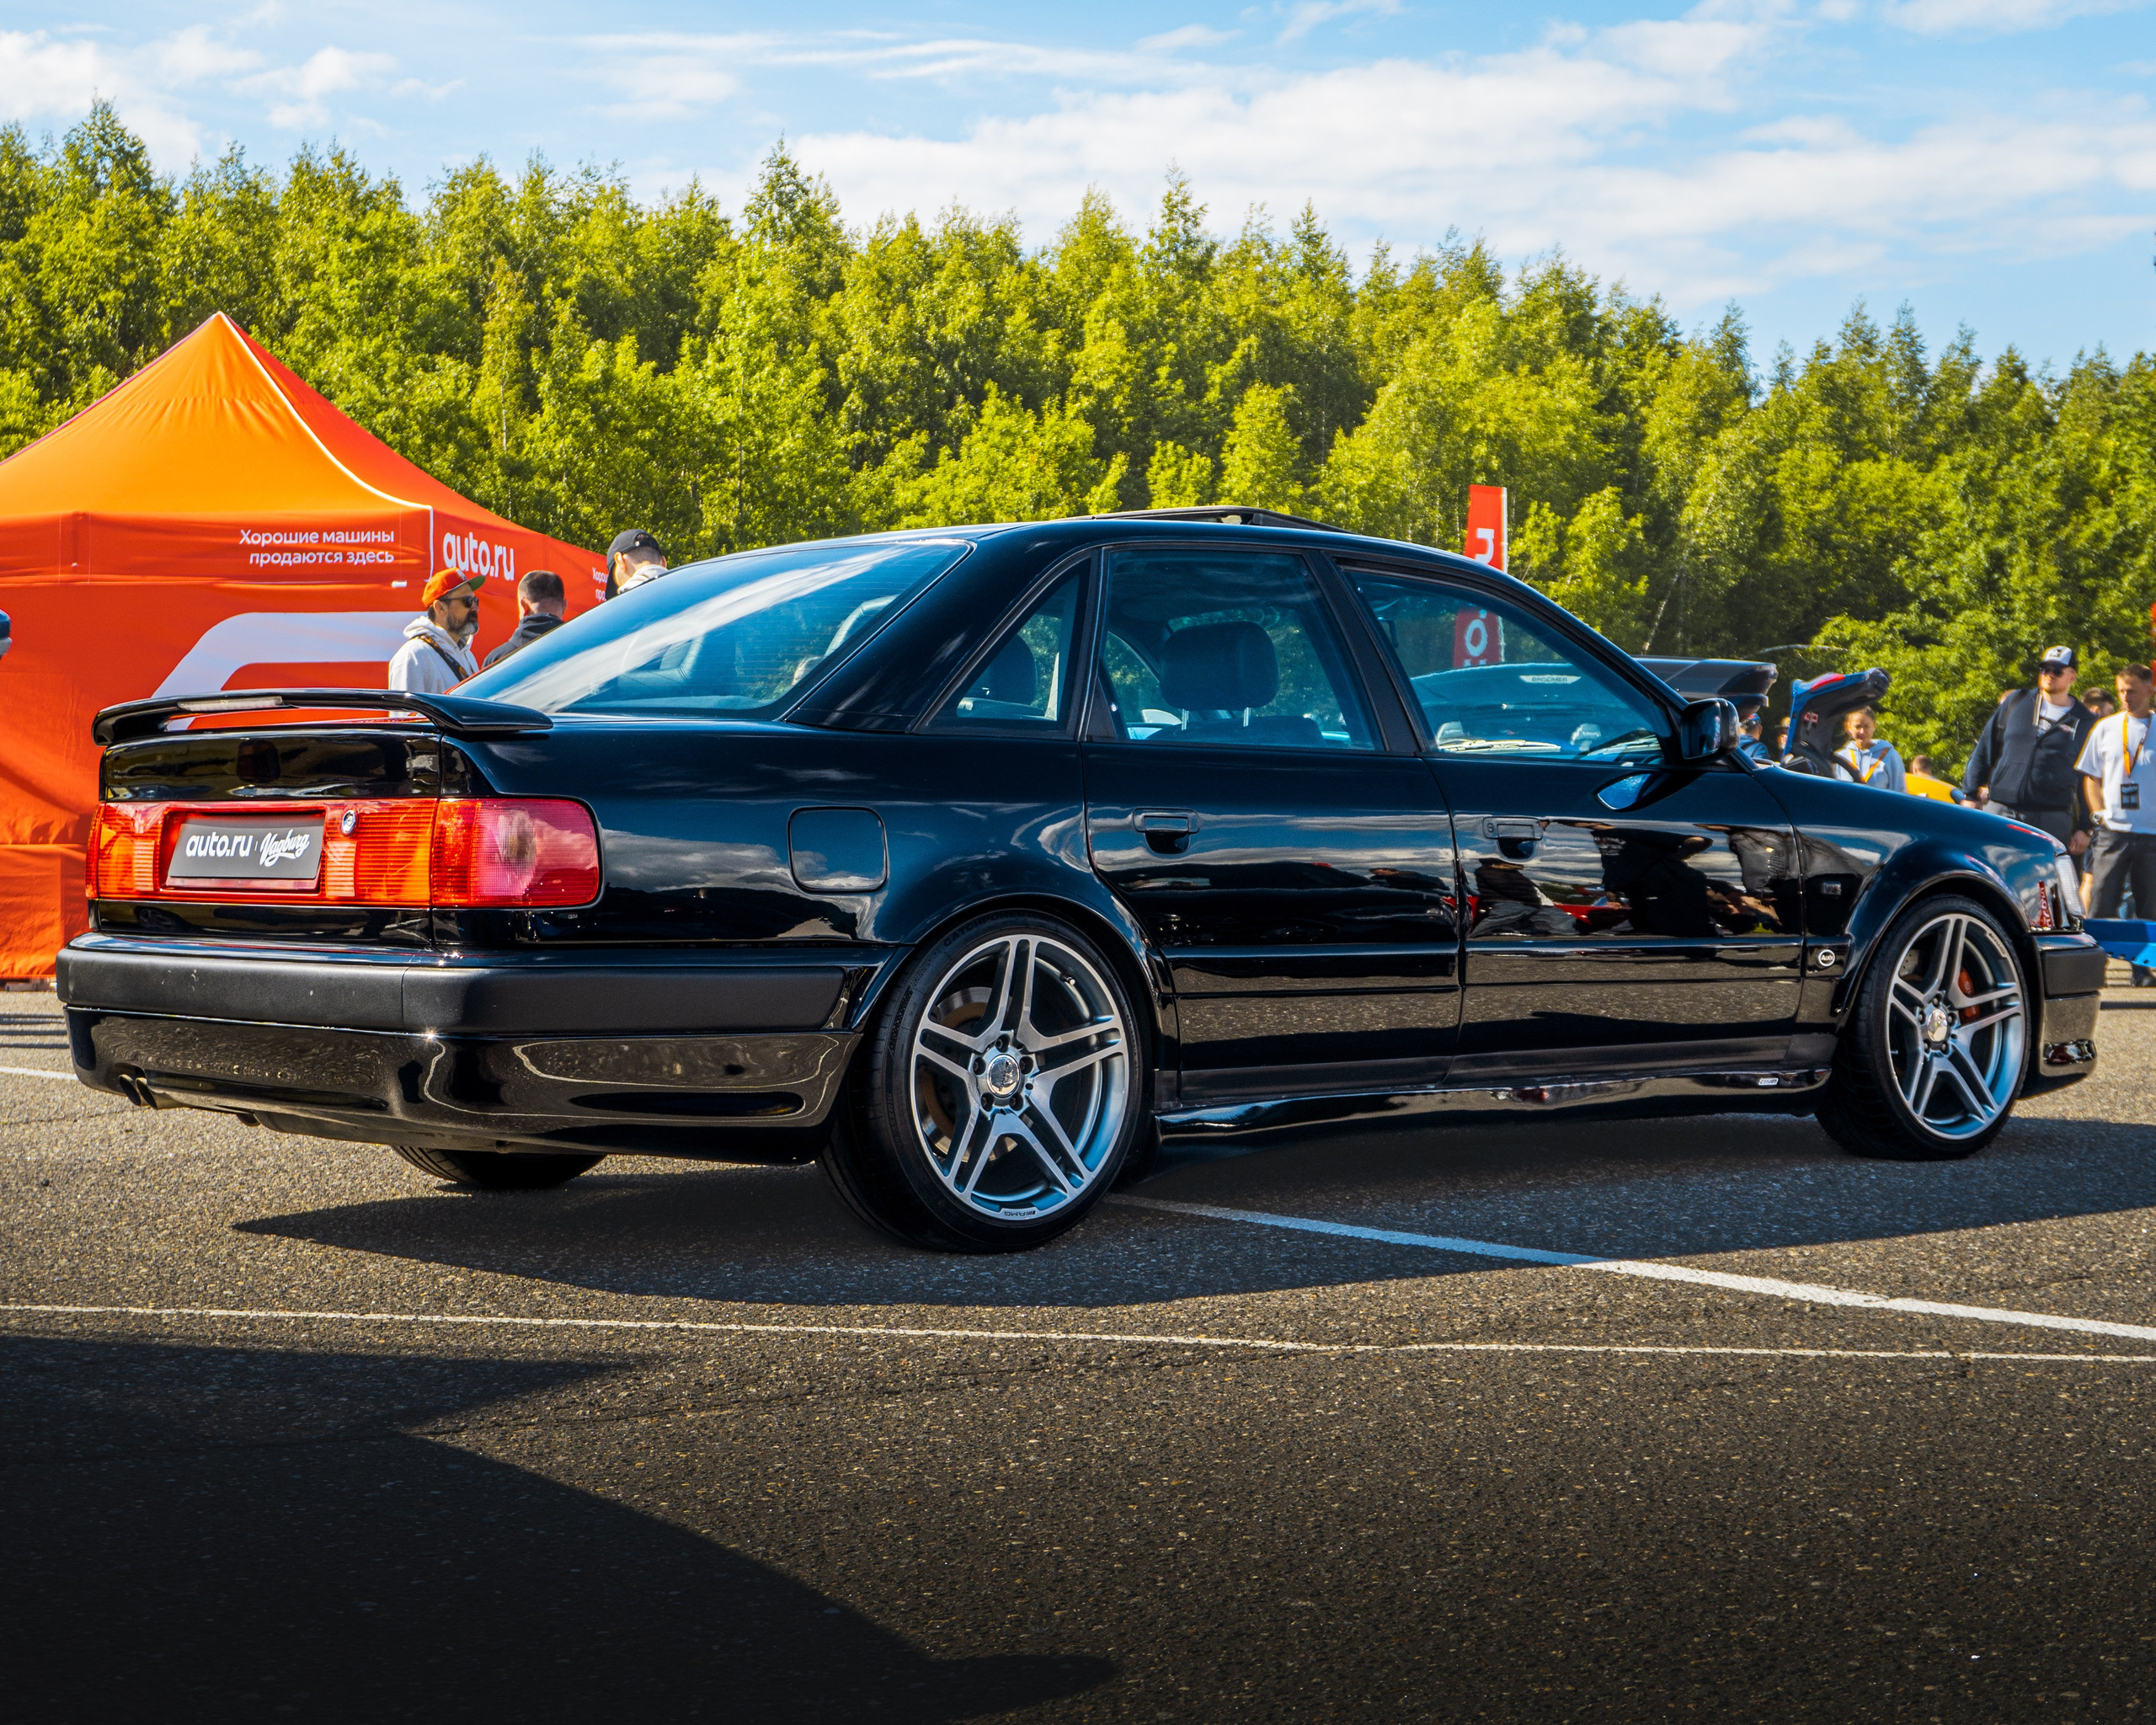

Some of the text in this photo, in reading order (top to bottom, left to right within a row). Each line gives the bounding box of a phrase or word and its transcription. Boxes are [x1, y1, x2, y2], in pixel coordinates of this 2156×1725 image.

[239, 529, 394, 546] Хорошие машины
[249, 551, 394, 567] продаются здесь
[443, 531, 515, 580] auto.ru
[185, 829, 310, 867] auto.ru Vagburg
